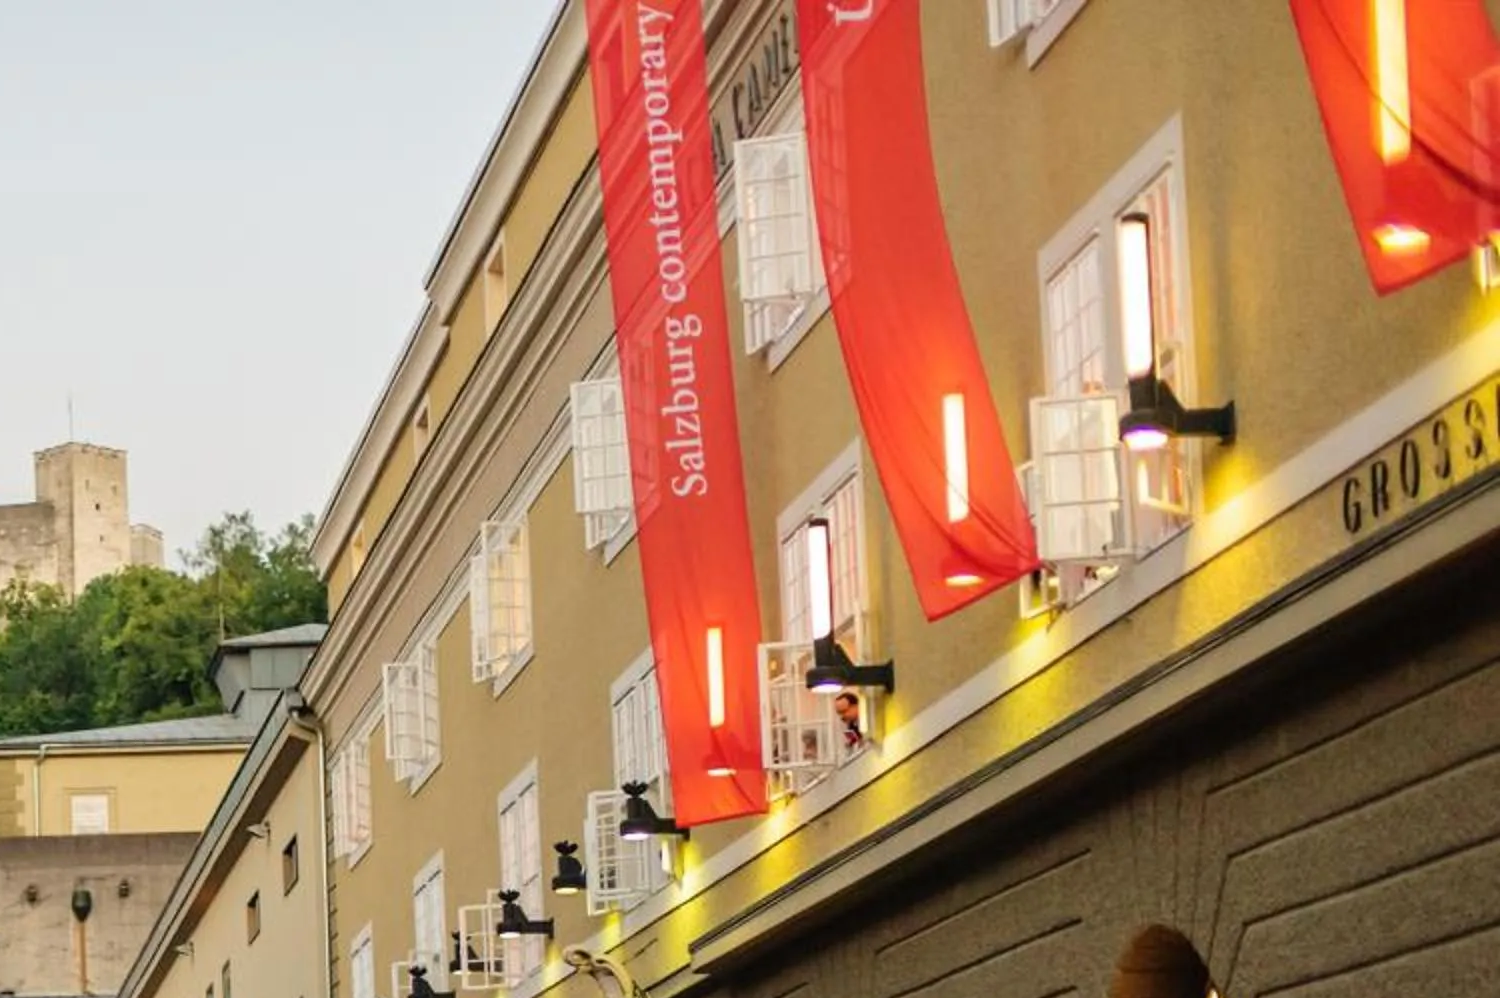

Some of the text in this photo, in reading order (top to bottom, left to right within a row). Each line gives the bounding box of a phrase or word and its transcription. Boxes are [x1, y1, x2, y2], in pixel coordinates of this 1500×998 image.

[637, 1, 708, 497] Salzburg contemporary
[1343, 384, 1500, 534] GROSS
